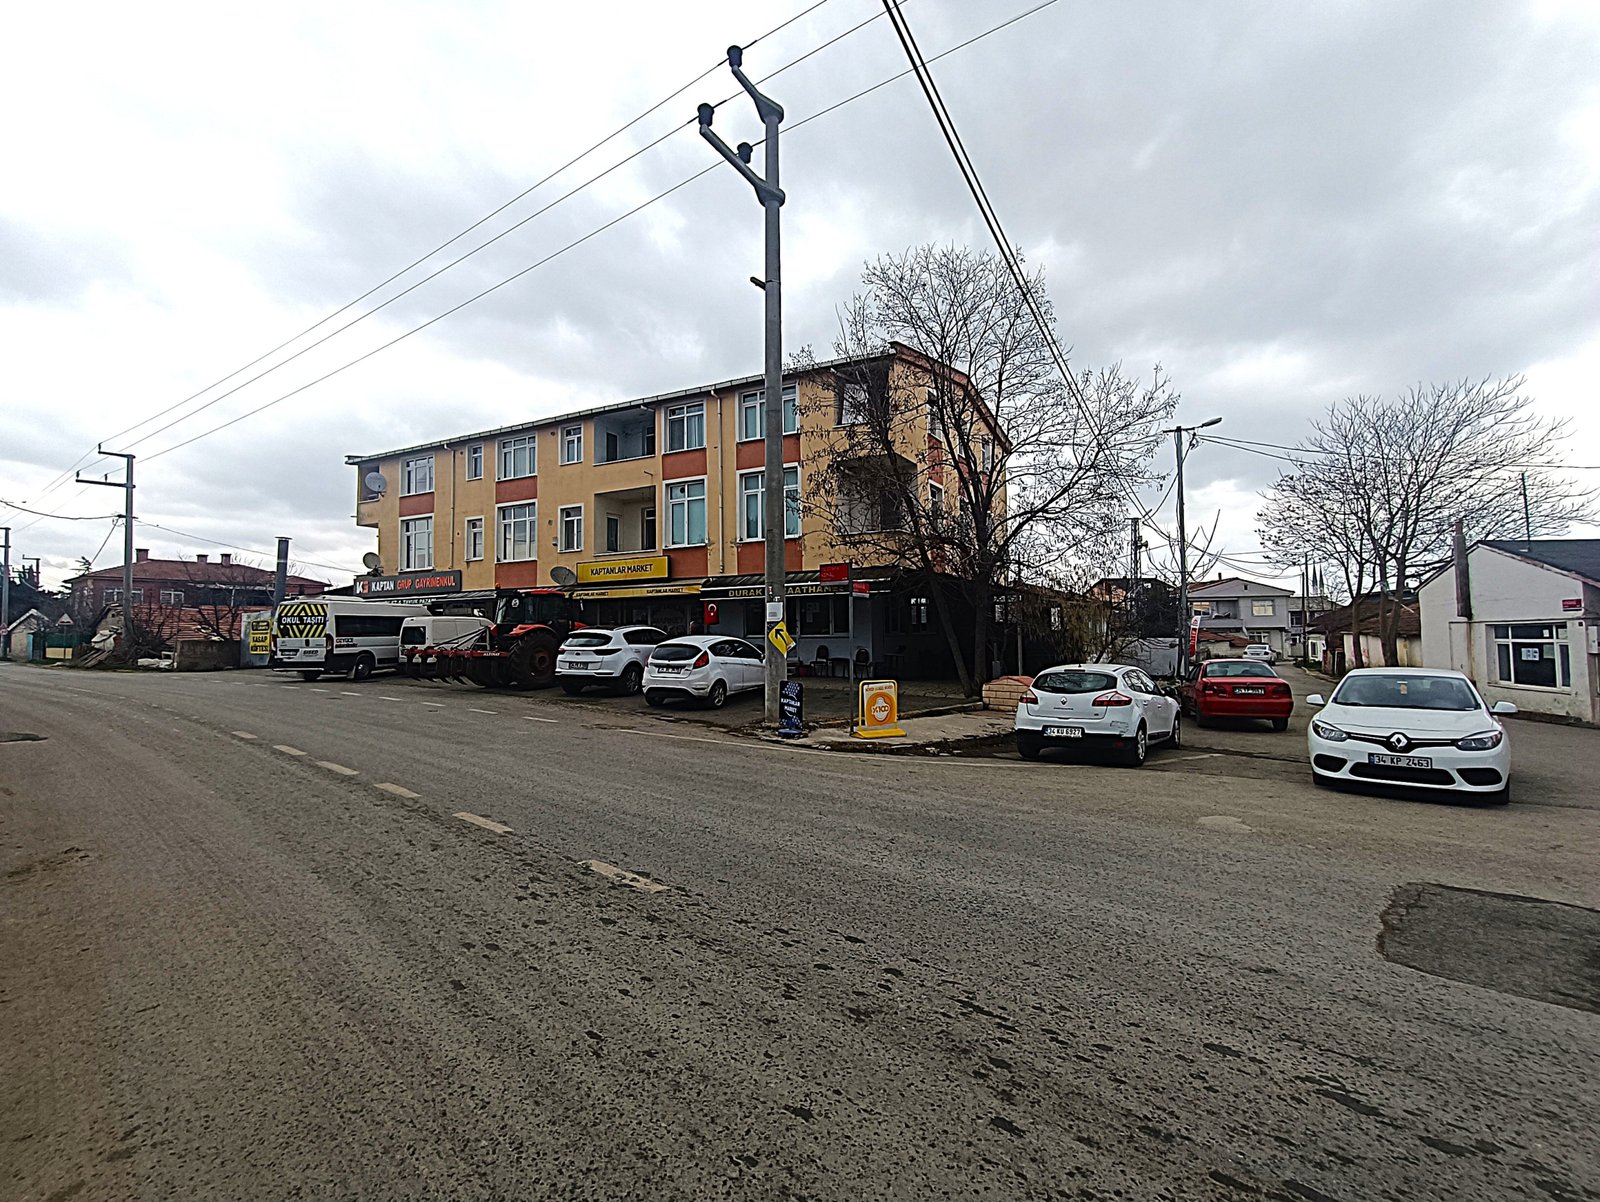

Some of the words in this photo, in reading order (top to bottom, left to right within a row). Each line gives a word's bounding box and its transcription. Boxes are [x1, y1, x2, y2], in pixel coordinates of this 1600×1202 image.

[590, 566, 627, 577] KAPTANLAR
[626, 563, 654, 573] MARKET
[371, 580, 395, 592] KAPTAN
[396, 579, 412, 590] GRUP
[728, 588, 763, 597] DURAK
[281, 616, 301, 624] OKUL
[1375, 755, 1387, 764] 34
[1390, 756, 1402, 765] KP
[1406, 758, 1430, 768] 2463
